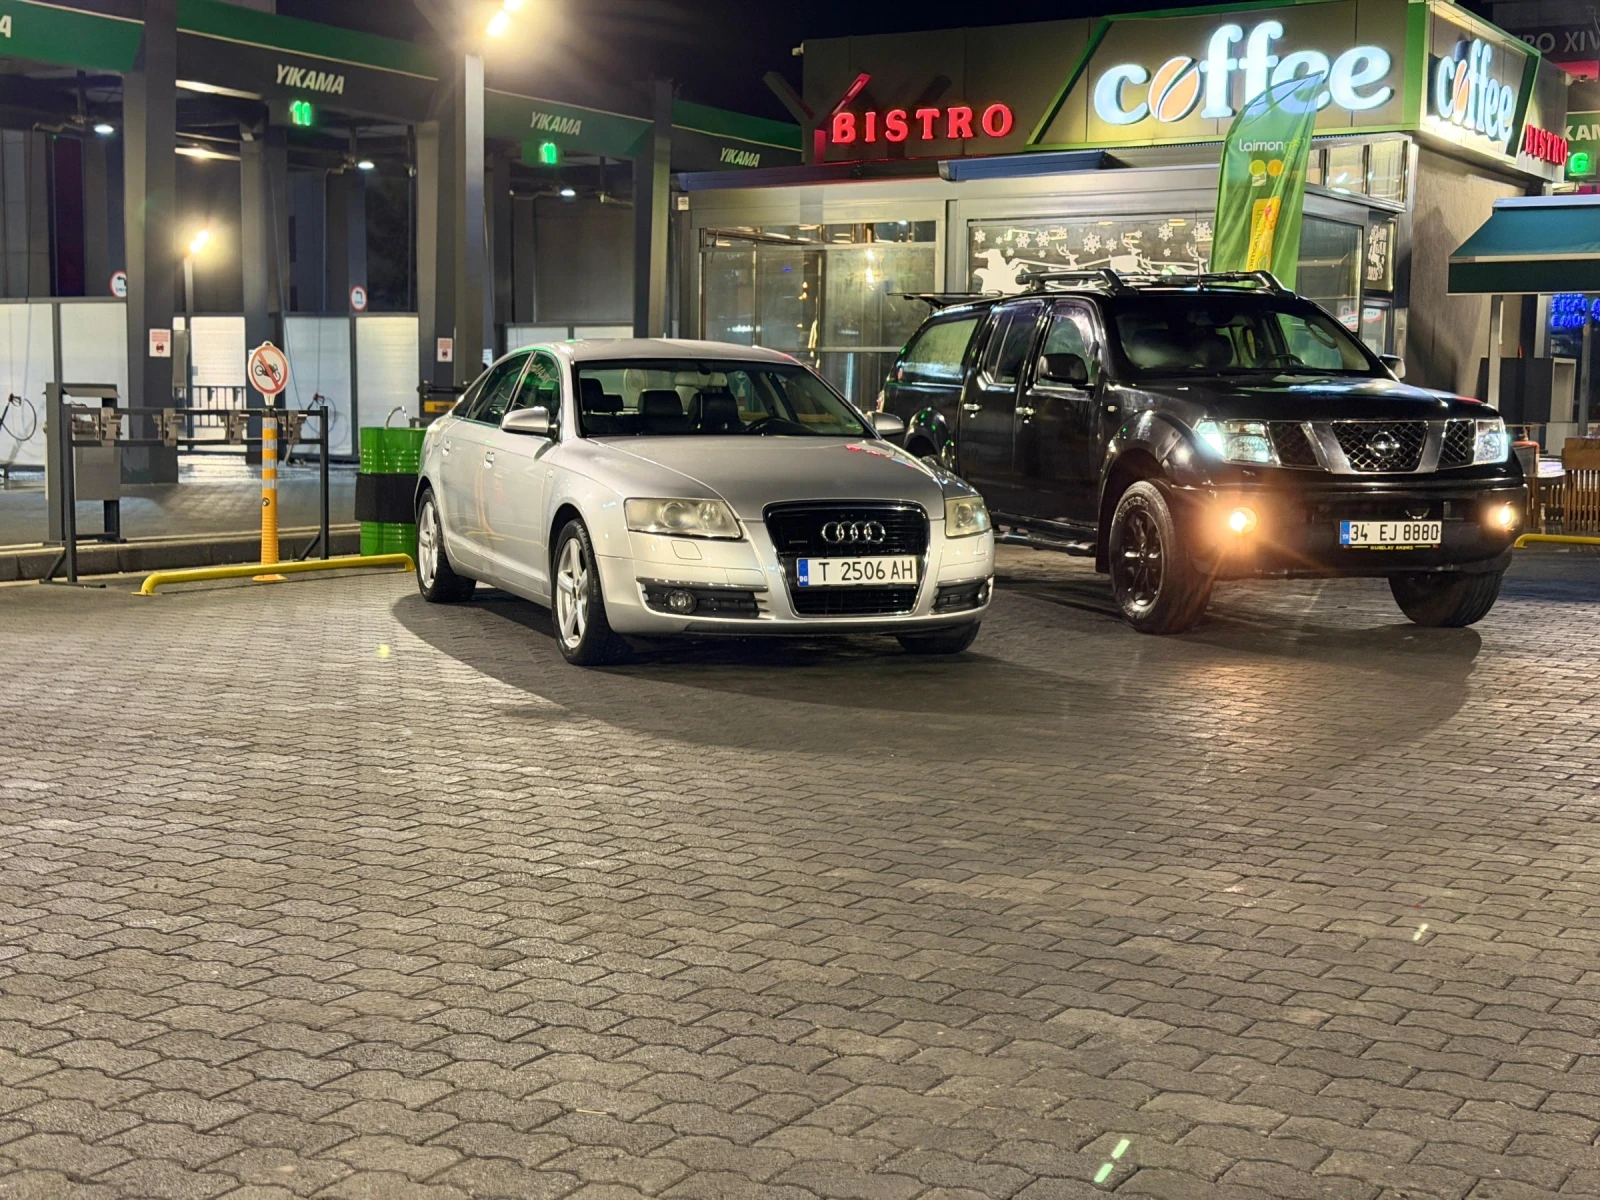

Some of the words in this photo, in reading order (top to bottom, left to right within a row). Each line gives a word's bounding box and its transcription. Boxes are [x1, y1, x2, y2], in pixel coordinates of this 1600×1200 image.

[276, 63, 345, 95] YIKAMA
[290, 100, 311, 127] 11
[530, 111, 582, 136] YIKAMA
[831, 103, 1013, 143] BISTRO
[720, 147, 761, 168] YIKAMA
[1525, 124, 1568, 166] BISTRO
[1570, 152, 1588, 173] 6
[1351, 524, 1368, 541] 34
[1379, 524, 1397, 541] EJ
[1402, 524, 1440, 541] 8880
[818, 562, 830, 581] T
[840, 561, 886, 581] 2506
[890, 560, 913, 579] AH
